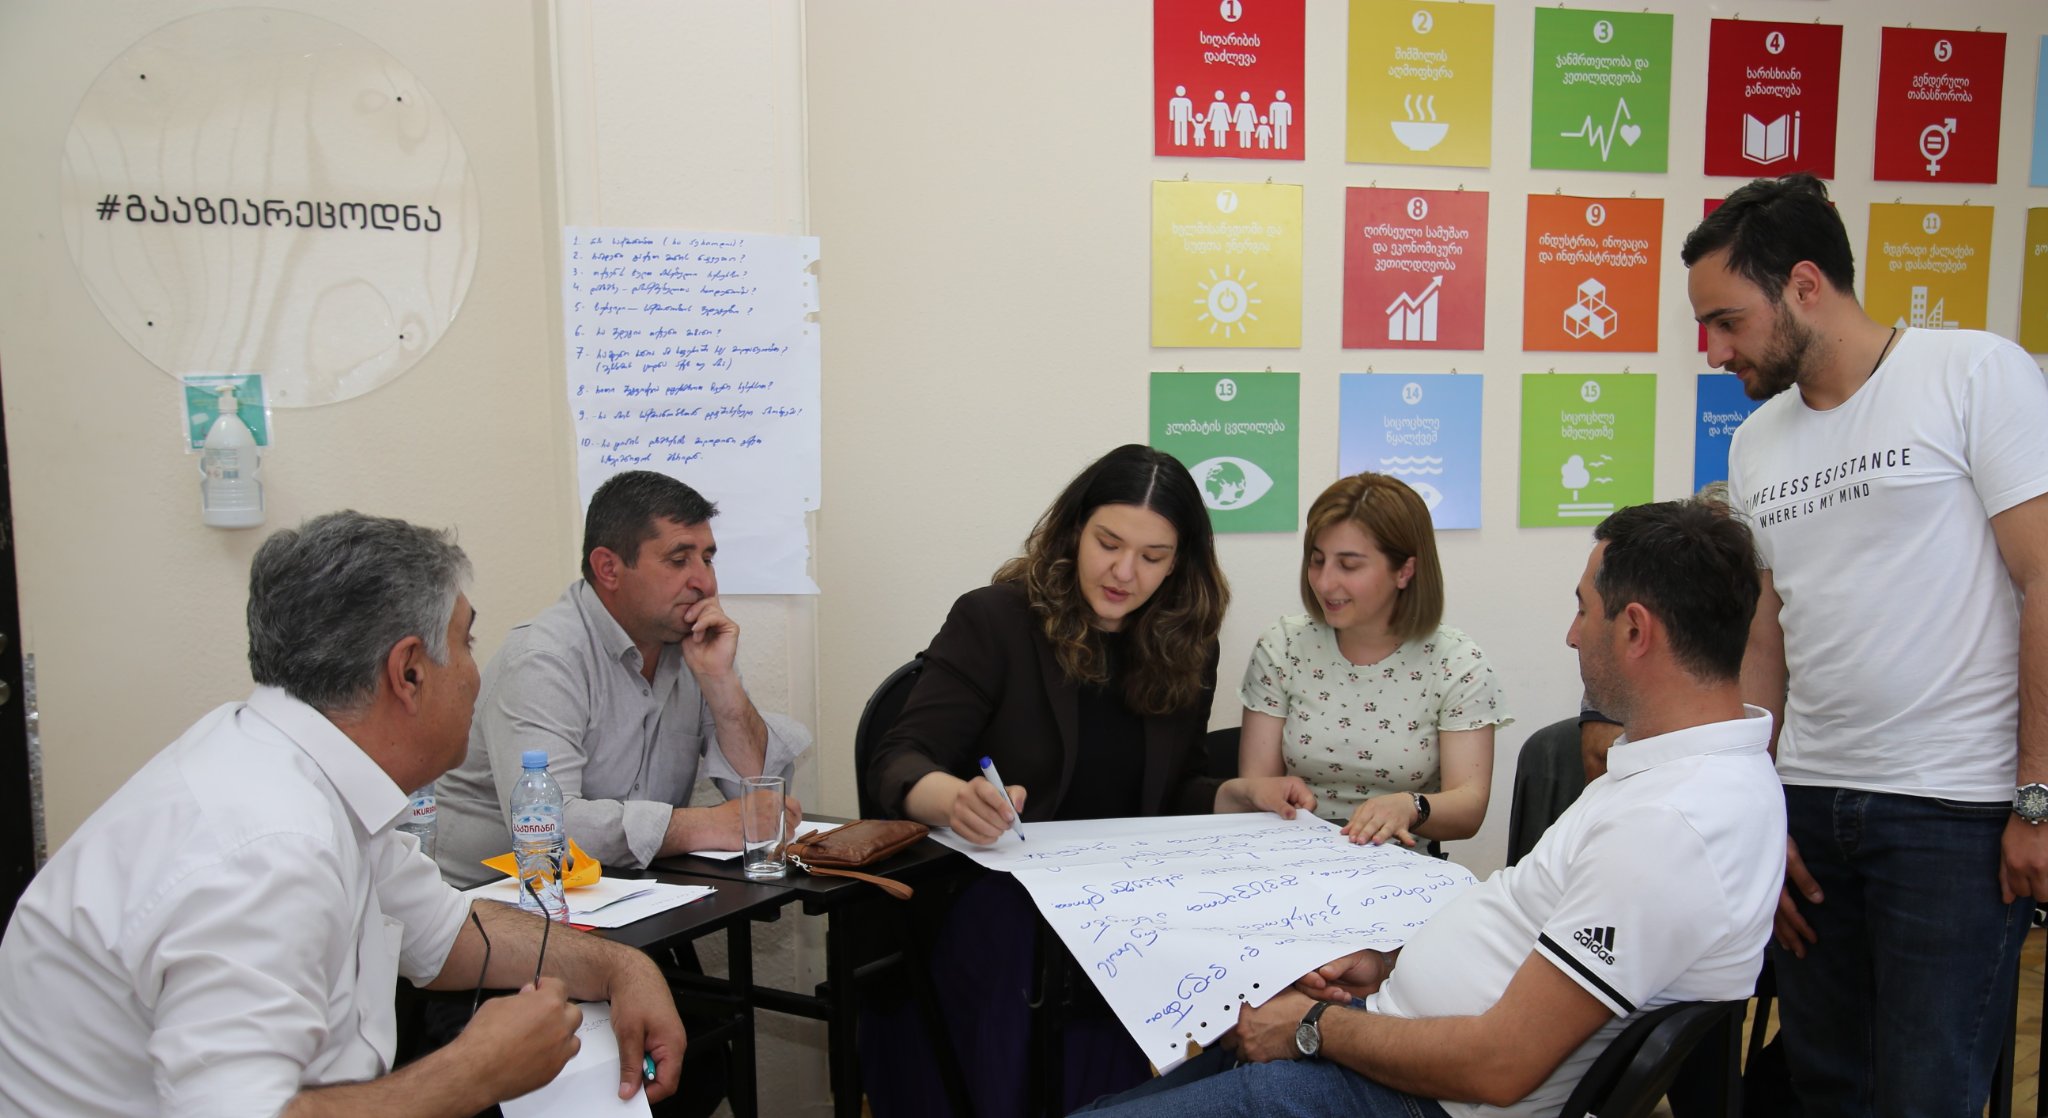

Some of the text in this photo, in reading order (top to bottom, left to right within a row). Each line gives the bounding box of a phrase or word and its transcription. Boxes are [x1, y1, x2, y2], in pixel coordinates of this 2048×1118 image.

[1227, 0, 1236, 18] 1
[1418, 12, 1427, 31] 2
[1200, 30, 1260, 48] სიღარიბის
[1599, 22, 1608, 40] 3
[1770, 33, 1780, 51] 4
[1939, 41, 1948, 59] 5
[1204, 49, 1256, 66] დაძლევა
[1395, 46, 1448, 64] შიმშილის
[1556, 53, 1649, 70] ჯანმრთელობა და
[1388, 64, 1453, 81] აღმოფხვრა
[1563, 71, 1642, 86] კეთილდღეობა
[1746, 66, 1801, 80] ხარისხიანი
[1913, 73, 1970, 89] გენდერული
[1745, 82, 1801, 98] განათლება
[1907, 88, 1973, 102] თანასწორობა
[1222, 191, 1231, 208] 7
[97, 194, 442, 232] #გააზიარეცოდნა
[1413, 200, 1423, 218] 8
[1591, 206, 1600, 223] 9
[1926, 218, 1938, 229] 11
[1364, 224, 1469, 241] ღირსეული სამუშაო
[1373, 241, 1463, 257] და ეკონომიკური
[1539, 233, 1648, 251] ინდუსტრია, ინოვაცია
[1884, 243, 1975, 258] მდგრადი ქალაქები
[1375, 258, 1456, 272] კეთილდღეობა
[1539, 250, 1648, 267] და ინფრასტრუქტურა
[1889, 258, 1967, 273] და დასახლებები
[1219, 384, 1234, 396] 13
[1406, 387, 1419, 399] 14
[1584, 385, 1597, 398] 15
[1384, 415, 1440, 431] სიცოცხლე
[1562, 410, 1615, 425] სიცოცხლე
[1166, 419, 1285, 435] კლიმატის ცვლილება
[1562, 425, 1614, 440] ხმელეთზე
[1709, 427, 1720, 437] და
[1386, 430, 1437, 446] წყალქვეშ
[1815, 448, 1911, 488] ESISTANCE
[1760, 483, 1870, 528] WHERE IS MY MIND
[1573, 930, 1615, 965] adidas
